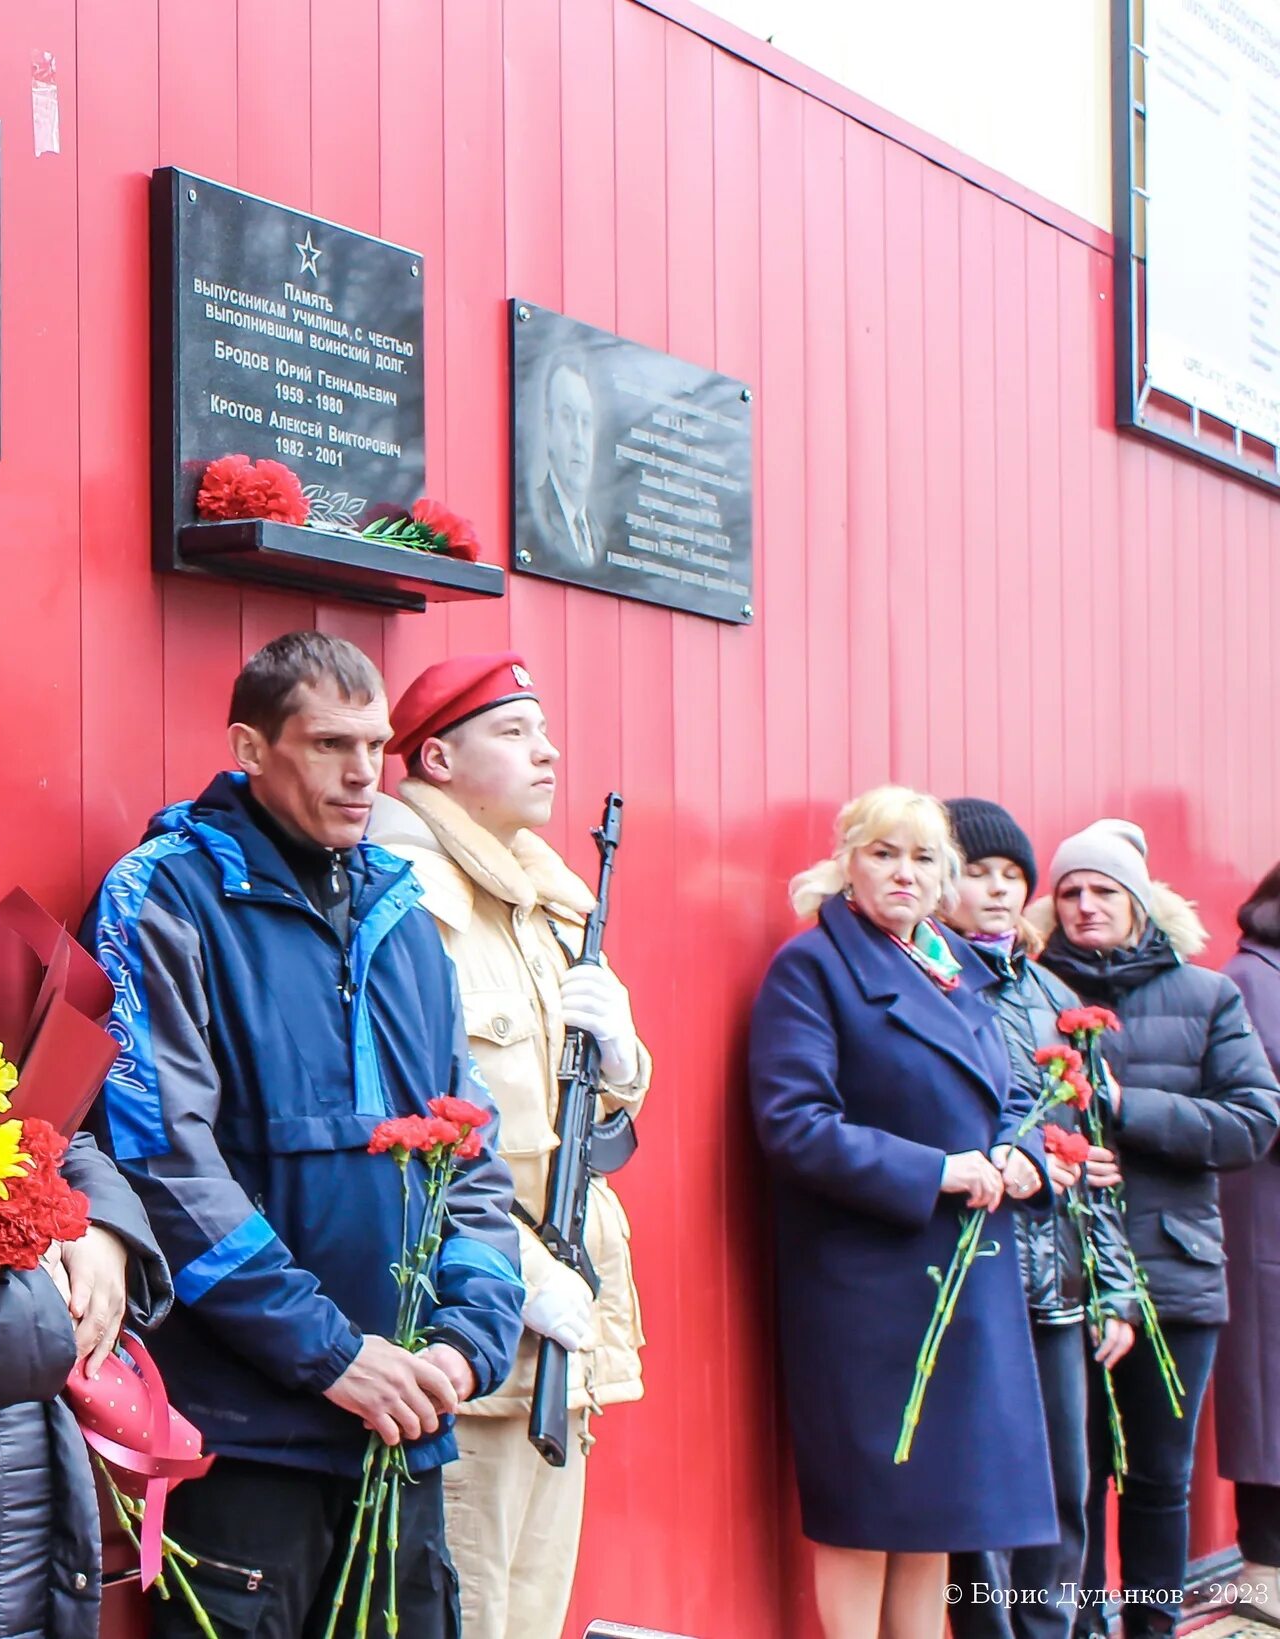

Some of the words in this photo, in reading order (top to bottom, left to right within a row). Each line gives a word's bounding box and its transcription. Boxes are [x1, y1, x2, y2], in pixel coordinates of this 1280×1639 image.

[193, 277, 287, 319] ВЫПУСКНИКАМ
[292, 306, 354, 342] УЧИЛИЩА,
[354, 326, 363, 342] С
[367, 329, 414, 357] ЧЕСТЬЮ
[283, 281, 334, 313] ПАМЯТЬ
[205, 302, 304, 346] ВЫПОЛНИВШИМ
[309, 332, 370, 364] ВОИНСКИЙ
[375, 353, 408, 375] ДОЛГ.
[214, 339, 270, 372] БРОДОВ
[275, 357, 313, 384] ЮРИЙ
[317, 369, 398, 408] ГЕННАДЬЕВИЧ
[275, 382, 304, 405] 1959
[315, 393, 344, 415] 1980
[210, 393, 263, 424] КРОТОВ
[269, 410, 323, 439] АЛЕКСЕЙ
[328, 424, 402, 459] ВИКТОРОВИЧ
[275, 436, 304, 458] 1982
[315, 446, 344, 467] 2001
